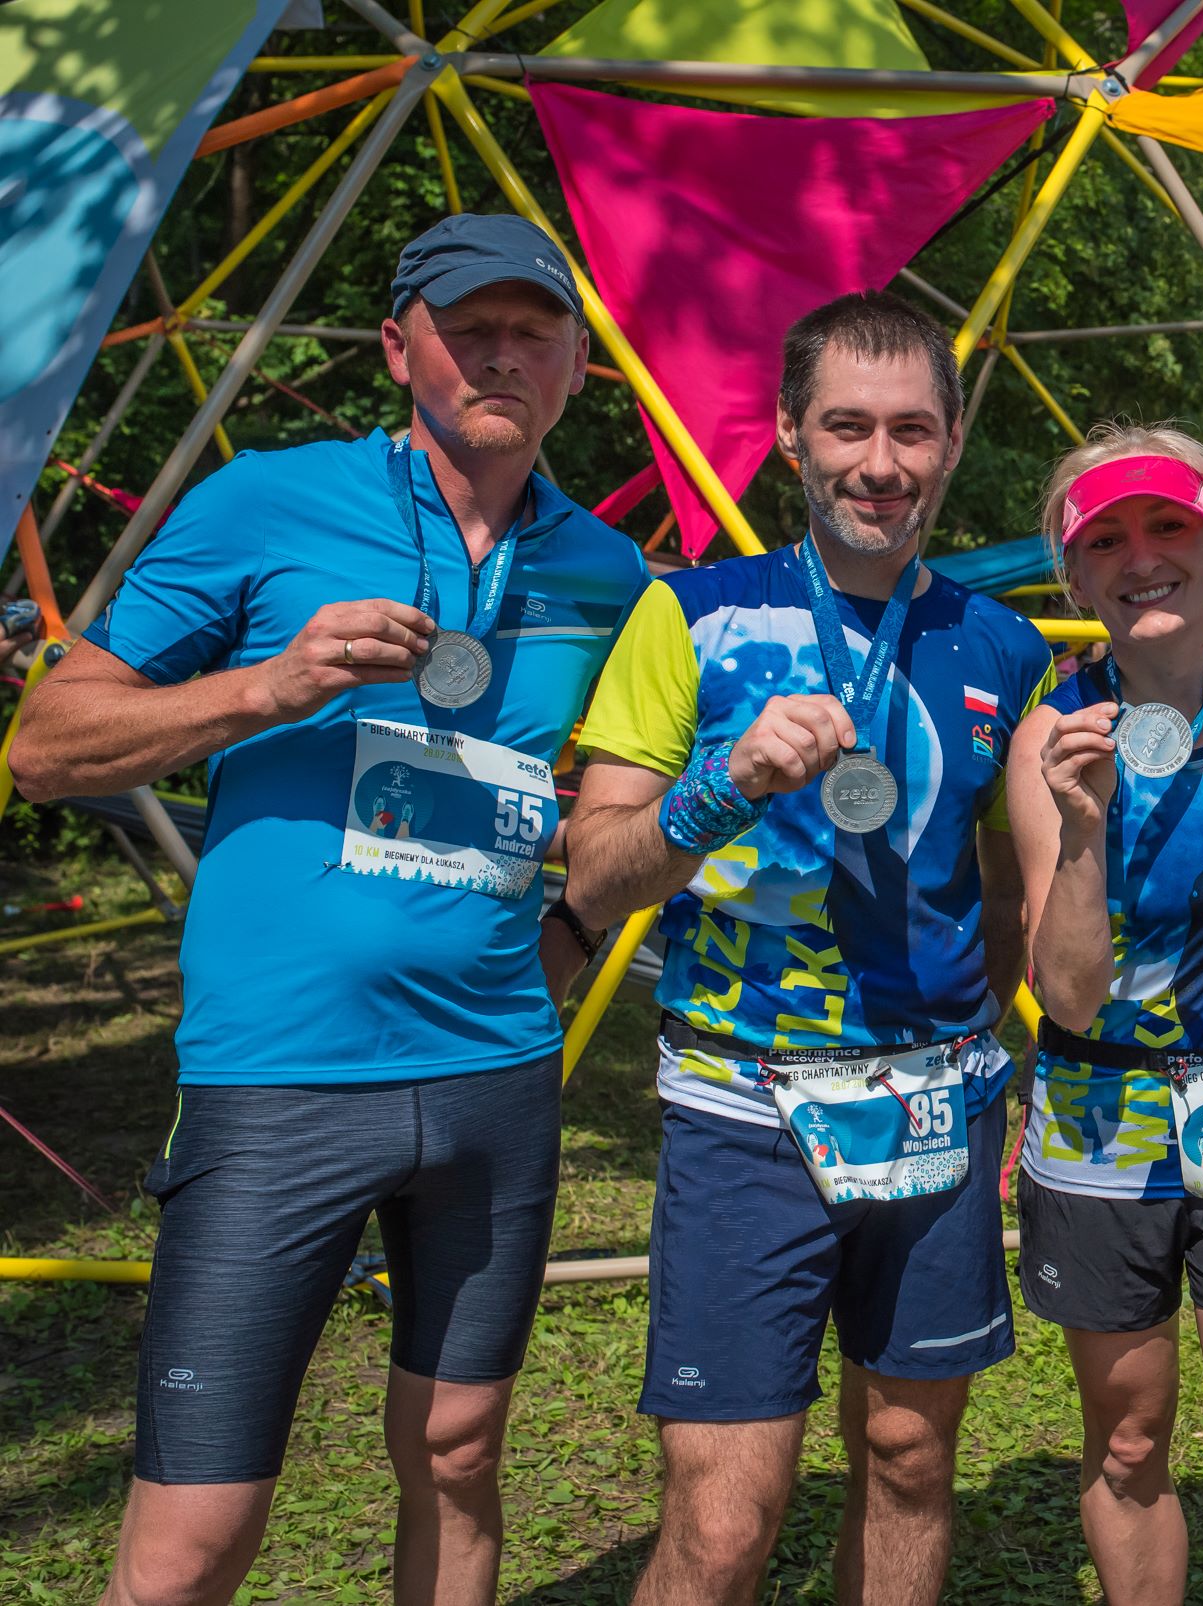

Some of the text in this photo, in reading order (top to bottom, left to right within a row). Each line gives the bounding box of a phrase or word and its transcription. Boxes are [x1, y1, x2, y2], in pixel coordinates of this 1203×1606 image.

[370, 725, 465, 750] BIEG CHARYTATYWNY
[517, 760, 549, 780] zeto
[839, 785, 881, 801] zeto
[494, 789, 544, 842] 55
[494, 836, 536, 858] Andrzej
[354, 844, 465, 871] 10 KM BIEGNIEMY DLA ŁUKASZA
[781, 1055, 835, 1063] recovery
[801, 1063, 870, 1080] CHARYTATYWNY
[908, 1088, 953, 1138] 85
[902, 1133, 951, 1154] Wojciech
[1037, 1270, 1062, 1289] Kalenji
[160, 1378, 203, 1392] Kalenji
[671, 1377, 706, 1389] Kalenji
